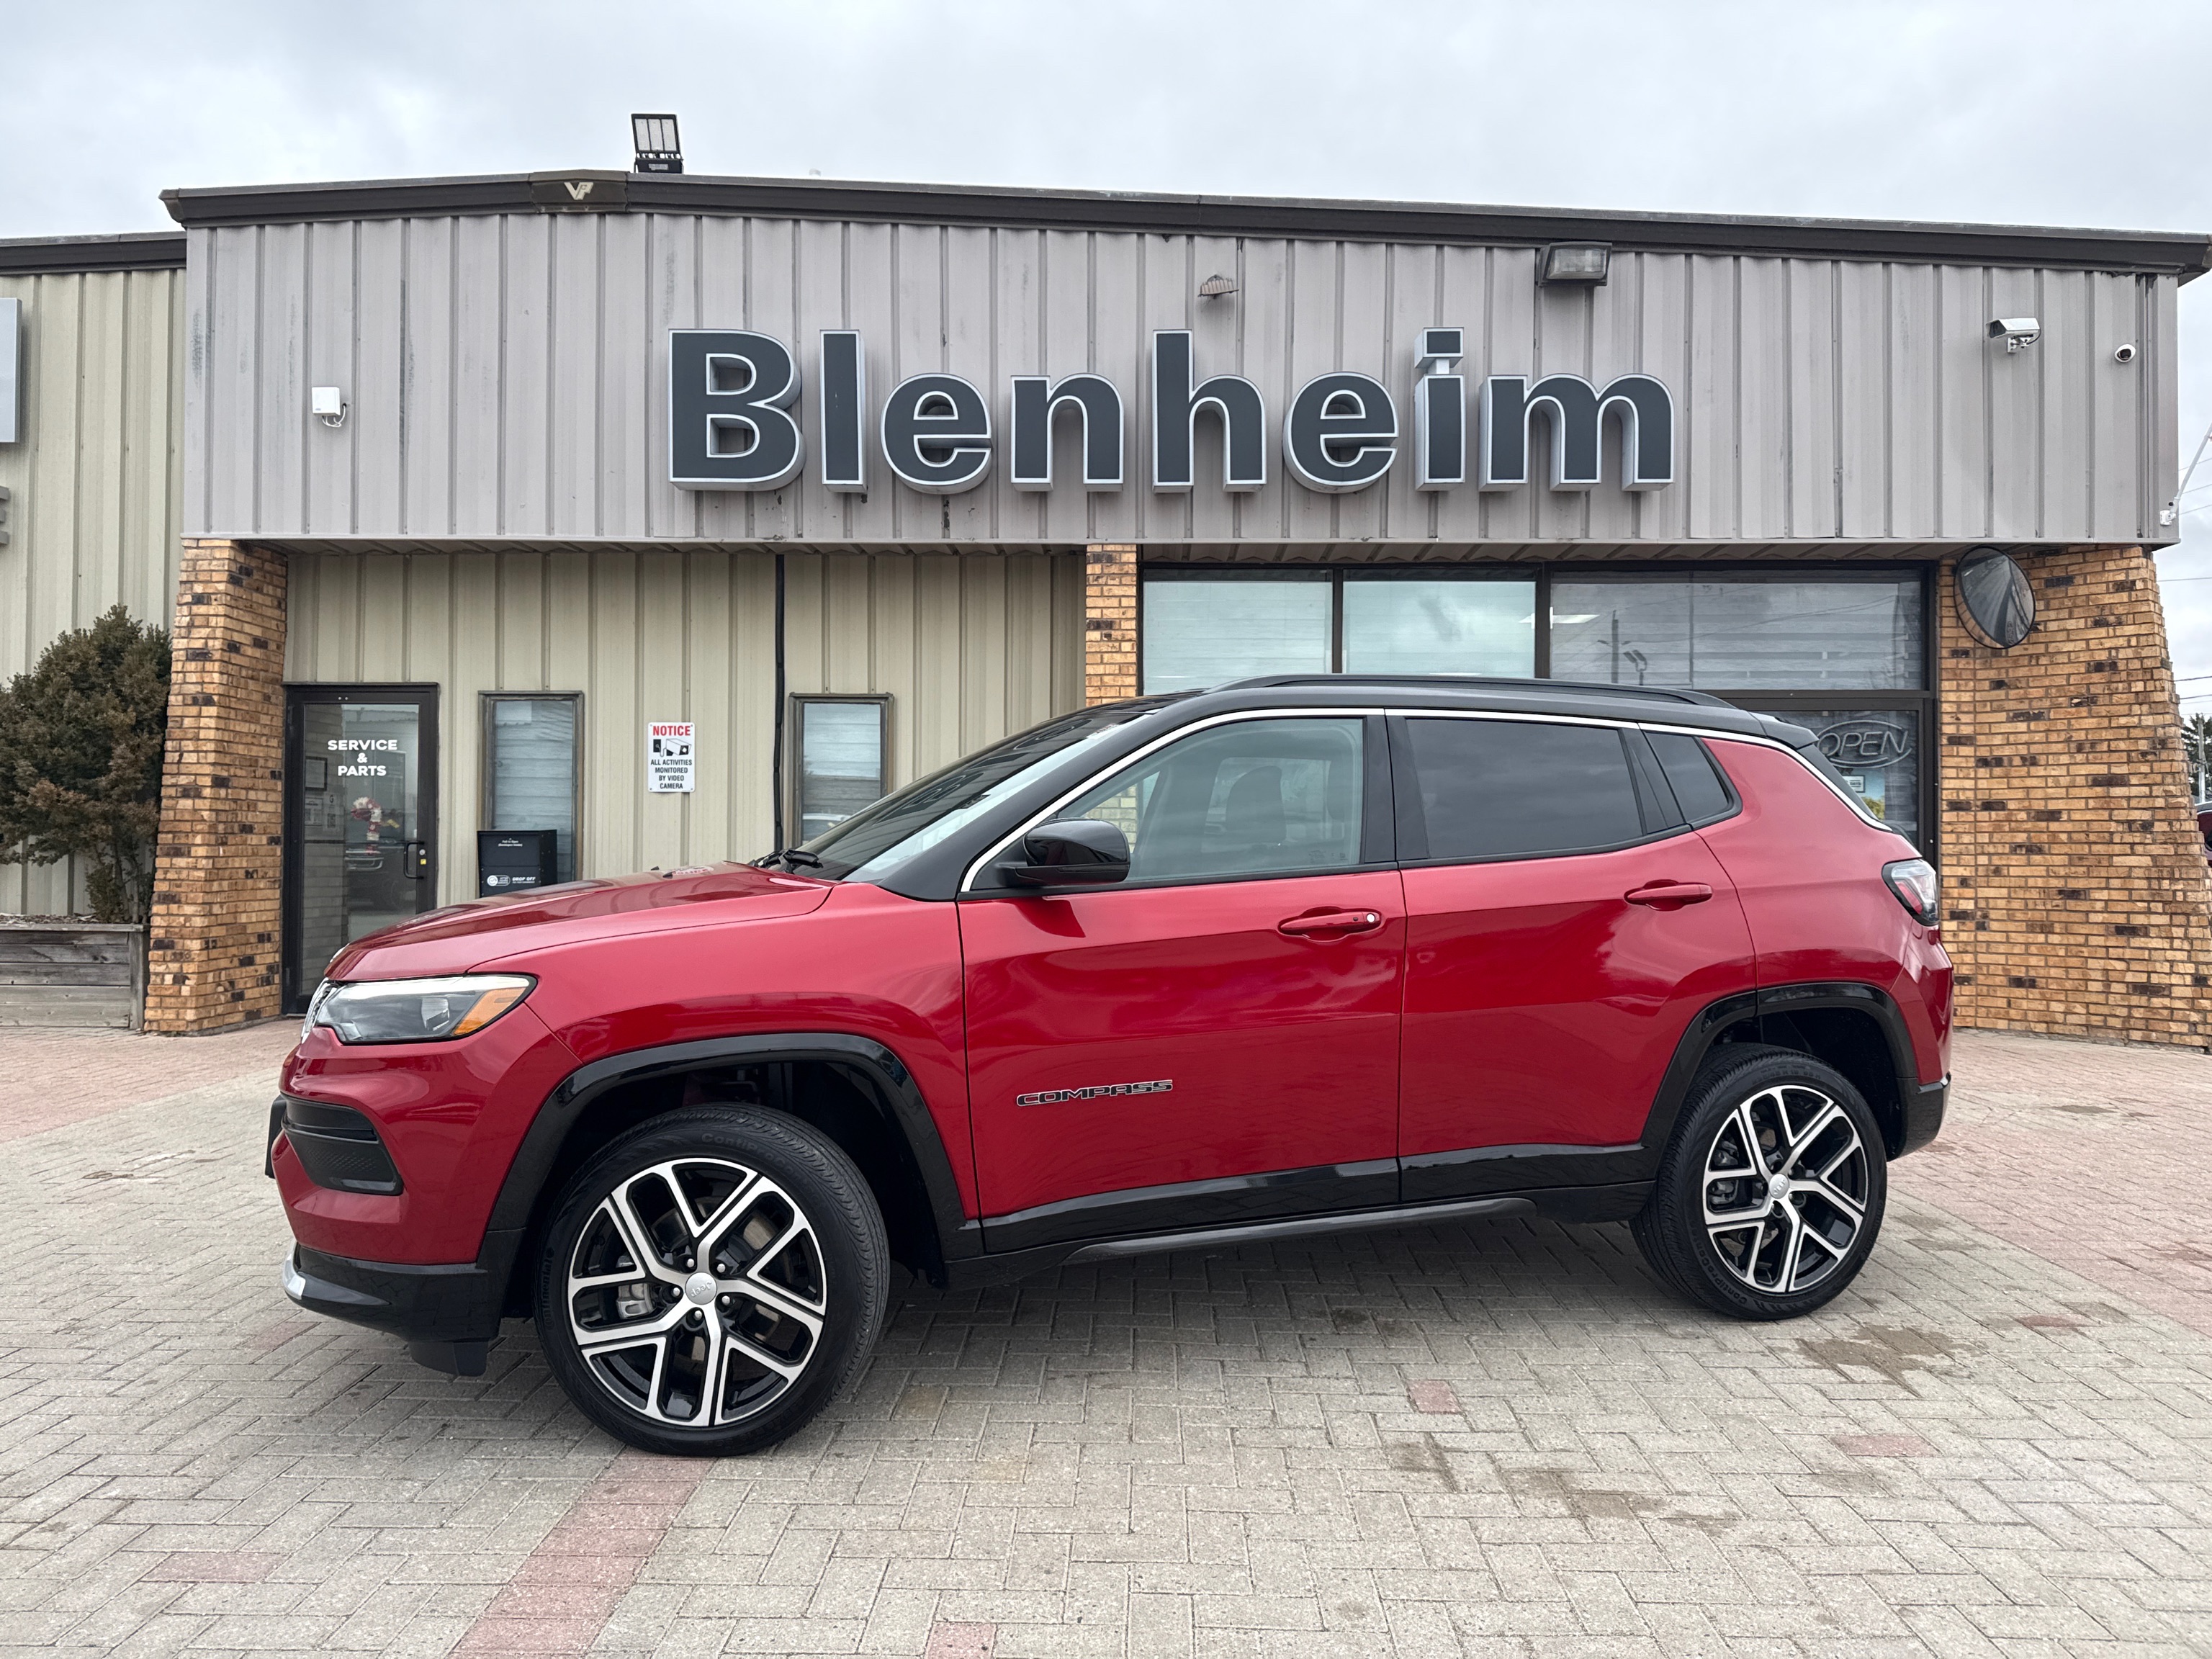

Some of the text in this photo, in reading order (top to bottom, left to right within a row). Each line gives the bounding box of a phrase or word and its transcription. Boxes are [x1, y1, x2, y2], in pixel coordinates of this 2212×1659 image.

[668, 328, 1675, 495] Blenheim
[652, 725, 691, 736] NOTICE
[328, 739, 397, 750] SERVICE
[1817, 730, 1908, 757] OPEN
[356, 752, 368, 763] &
[338, 765, 387, 776] PARTS
[1016, 1079, 1173, 1107] COMPASS
[691, 1281, 713, 1298] Jeep
